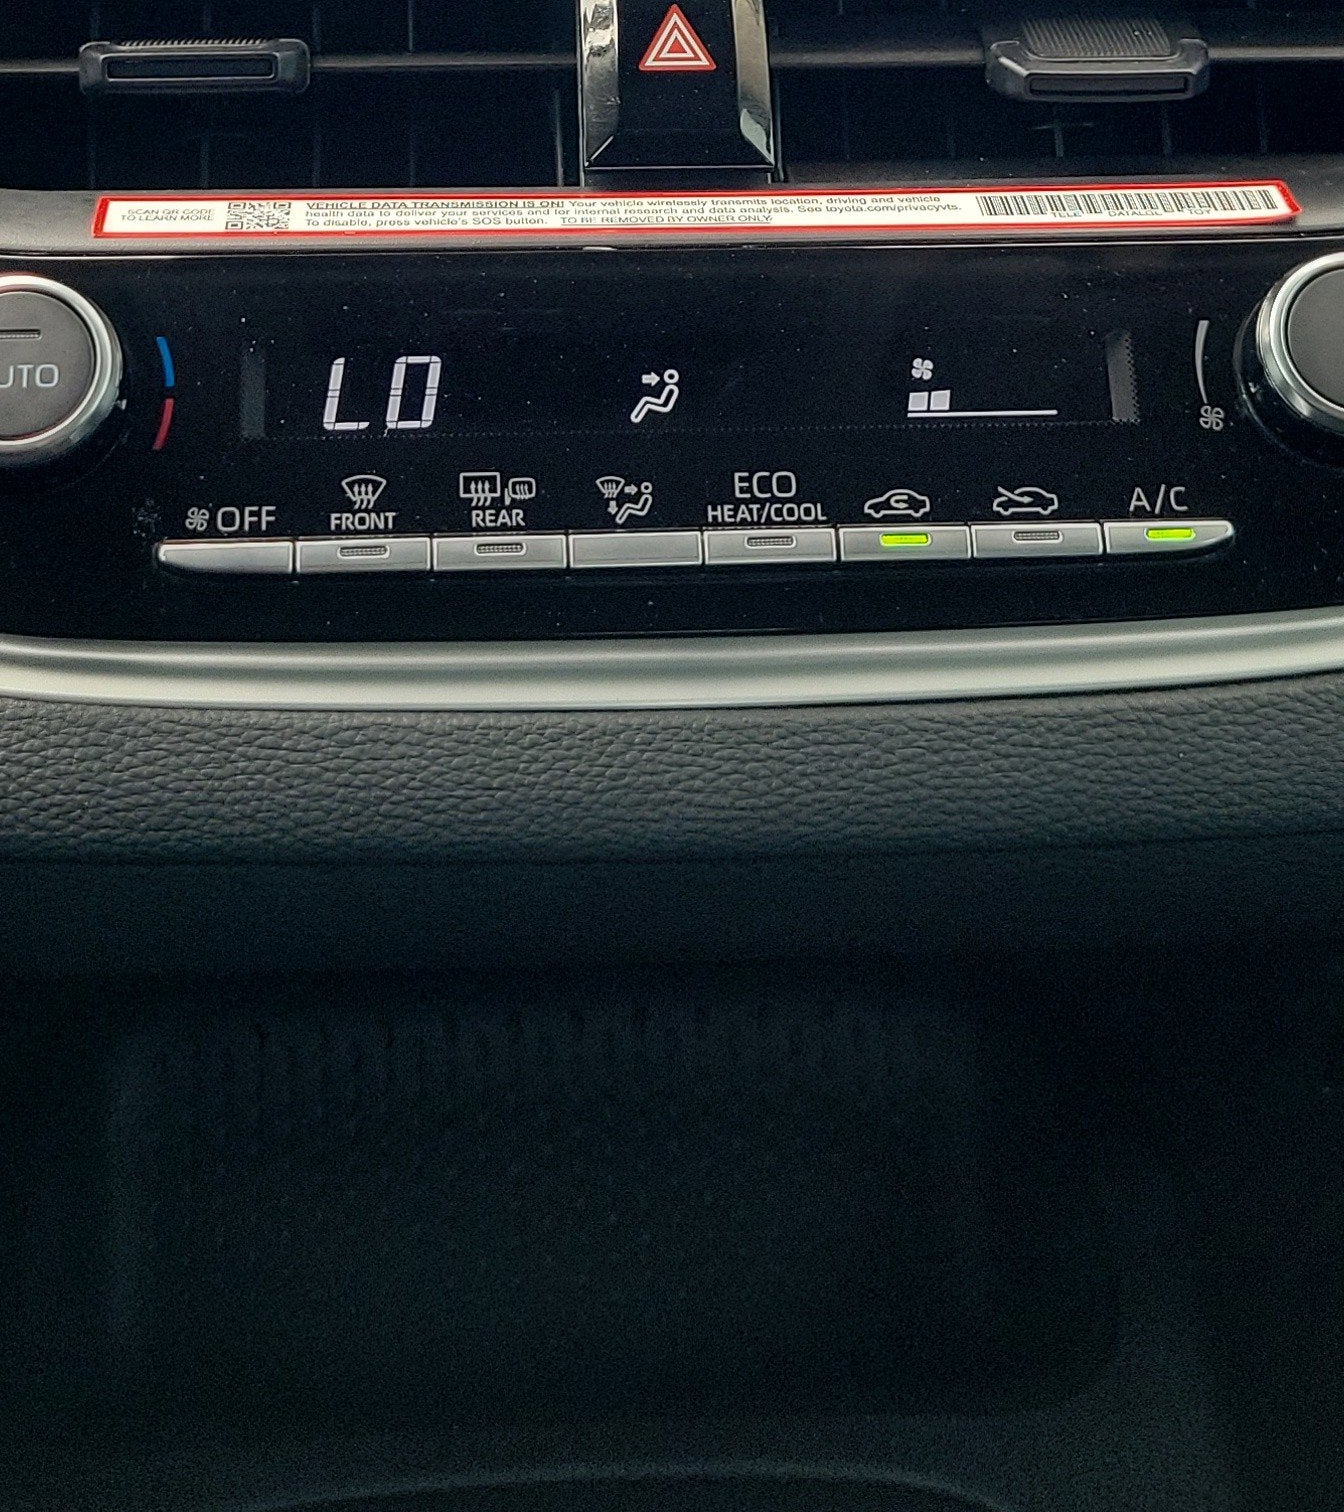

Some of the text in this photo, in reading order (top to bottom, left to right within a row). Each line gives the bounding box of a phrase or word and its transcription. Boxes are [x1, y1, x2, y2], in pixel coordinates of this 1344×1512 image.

[322, 354, 443, 432] LO
[733, 470, 798, 500] ECO
[1128, 484, 1189, 513] A/C
[215, 506, 277, 533] OFF
[329, 511, 397, 532] FRONT
[470, 509, 526, 528] REAR
[706, 501, 828, 523] HEAT/COOL
